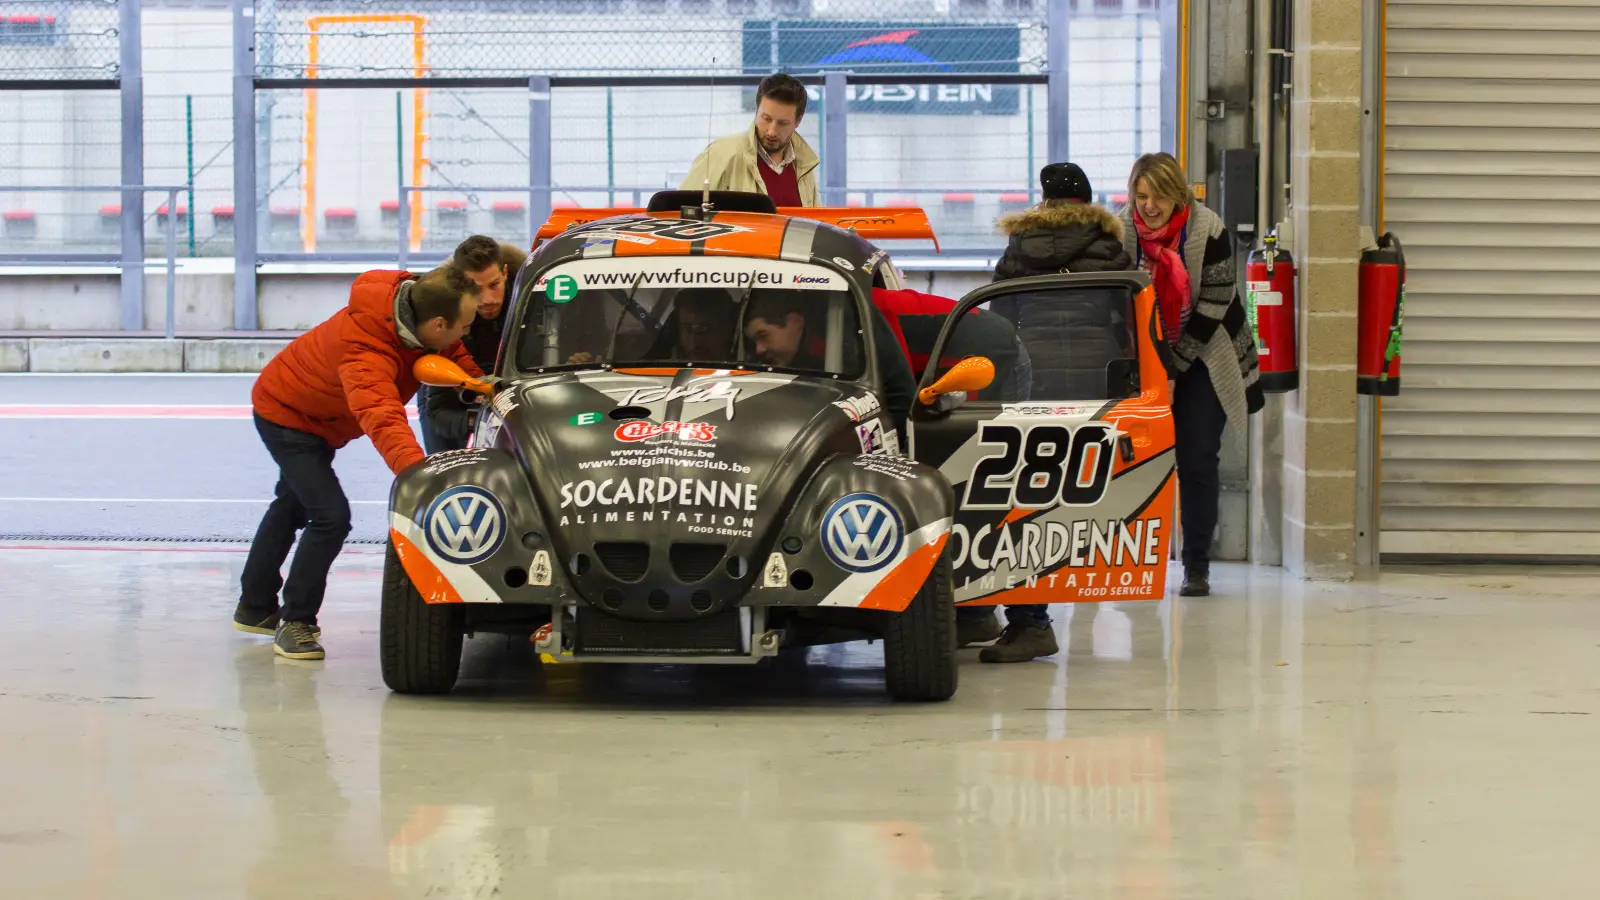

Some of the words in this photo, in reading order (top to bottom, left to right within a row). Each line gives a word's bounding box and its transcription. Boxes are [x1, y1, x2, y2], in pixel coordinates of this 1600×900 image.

[806, 84, 991, 103] DESTEIN
[583, 269, 783, 286] wwwvwfuncup.eu
[792, 273, 830, 284] KRONOS
[553, 277, 571, 300] E
[577, 412, 595, 425] E
[610, 447, 715, 459] www.chichis.be
[578, 457, 752, 474] www.belgianvwclub.be
[960, 419, 1119, 511] 280
[559, 476, 758, 511] SOCARDENNE
[559, 510, 754, 528] ALIMENTATION
[688, 525, 714, 535] FOOD
[716, 527, 753, 538] SERVICE
[952, 518, 1162, 571] OCARDENNE
[1078, 586, 1108, 597] FOOD
[1110, 586, 1153, 596] SERVICE
